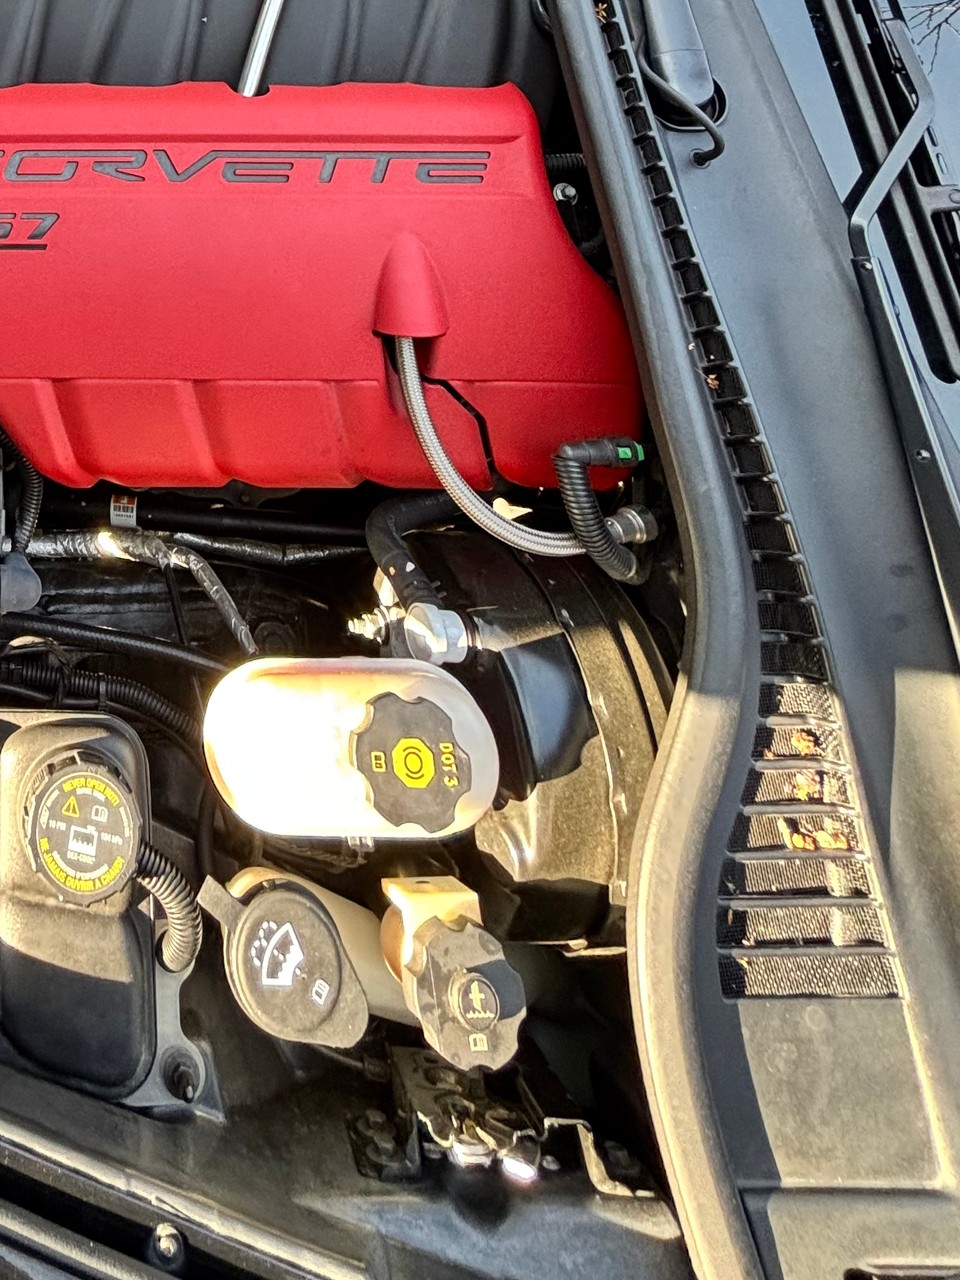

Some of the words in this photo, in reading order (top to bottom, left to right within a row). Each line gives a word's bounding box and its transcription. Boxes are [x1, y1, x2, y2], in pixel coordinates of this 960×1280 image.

[439, 742, 459, 773] DOT
[62, 777, 86, 793] NEVER
[86, 778, 106, 793] OPEN
[443, 775, 460, 788] 3
[43, 852, 67, 883] JAMAIS
[65, 876, 94, 892] OUVRIR
